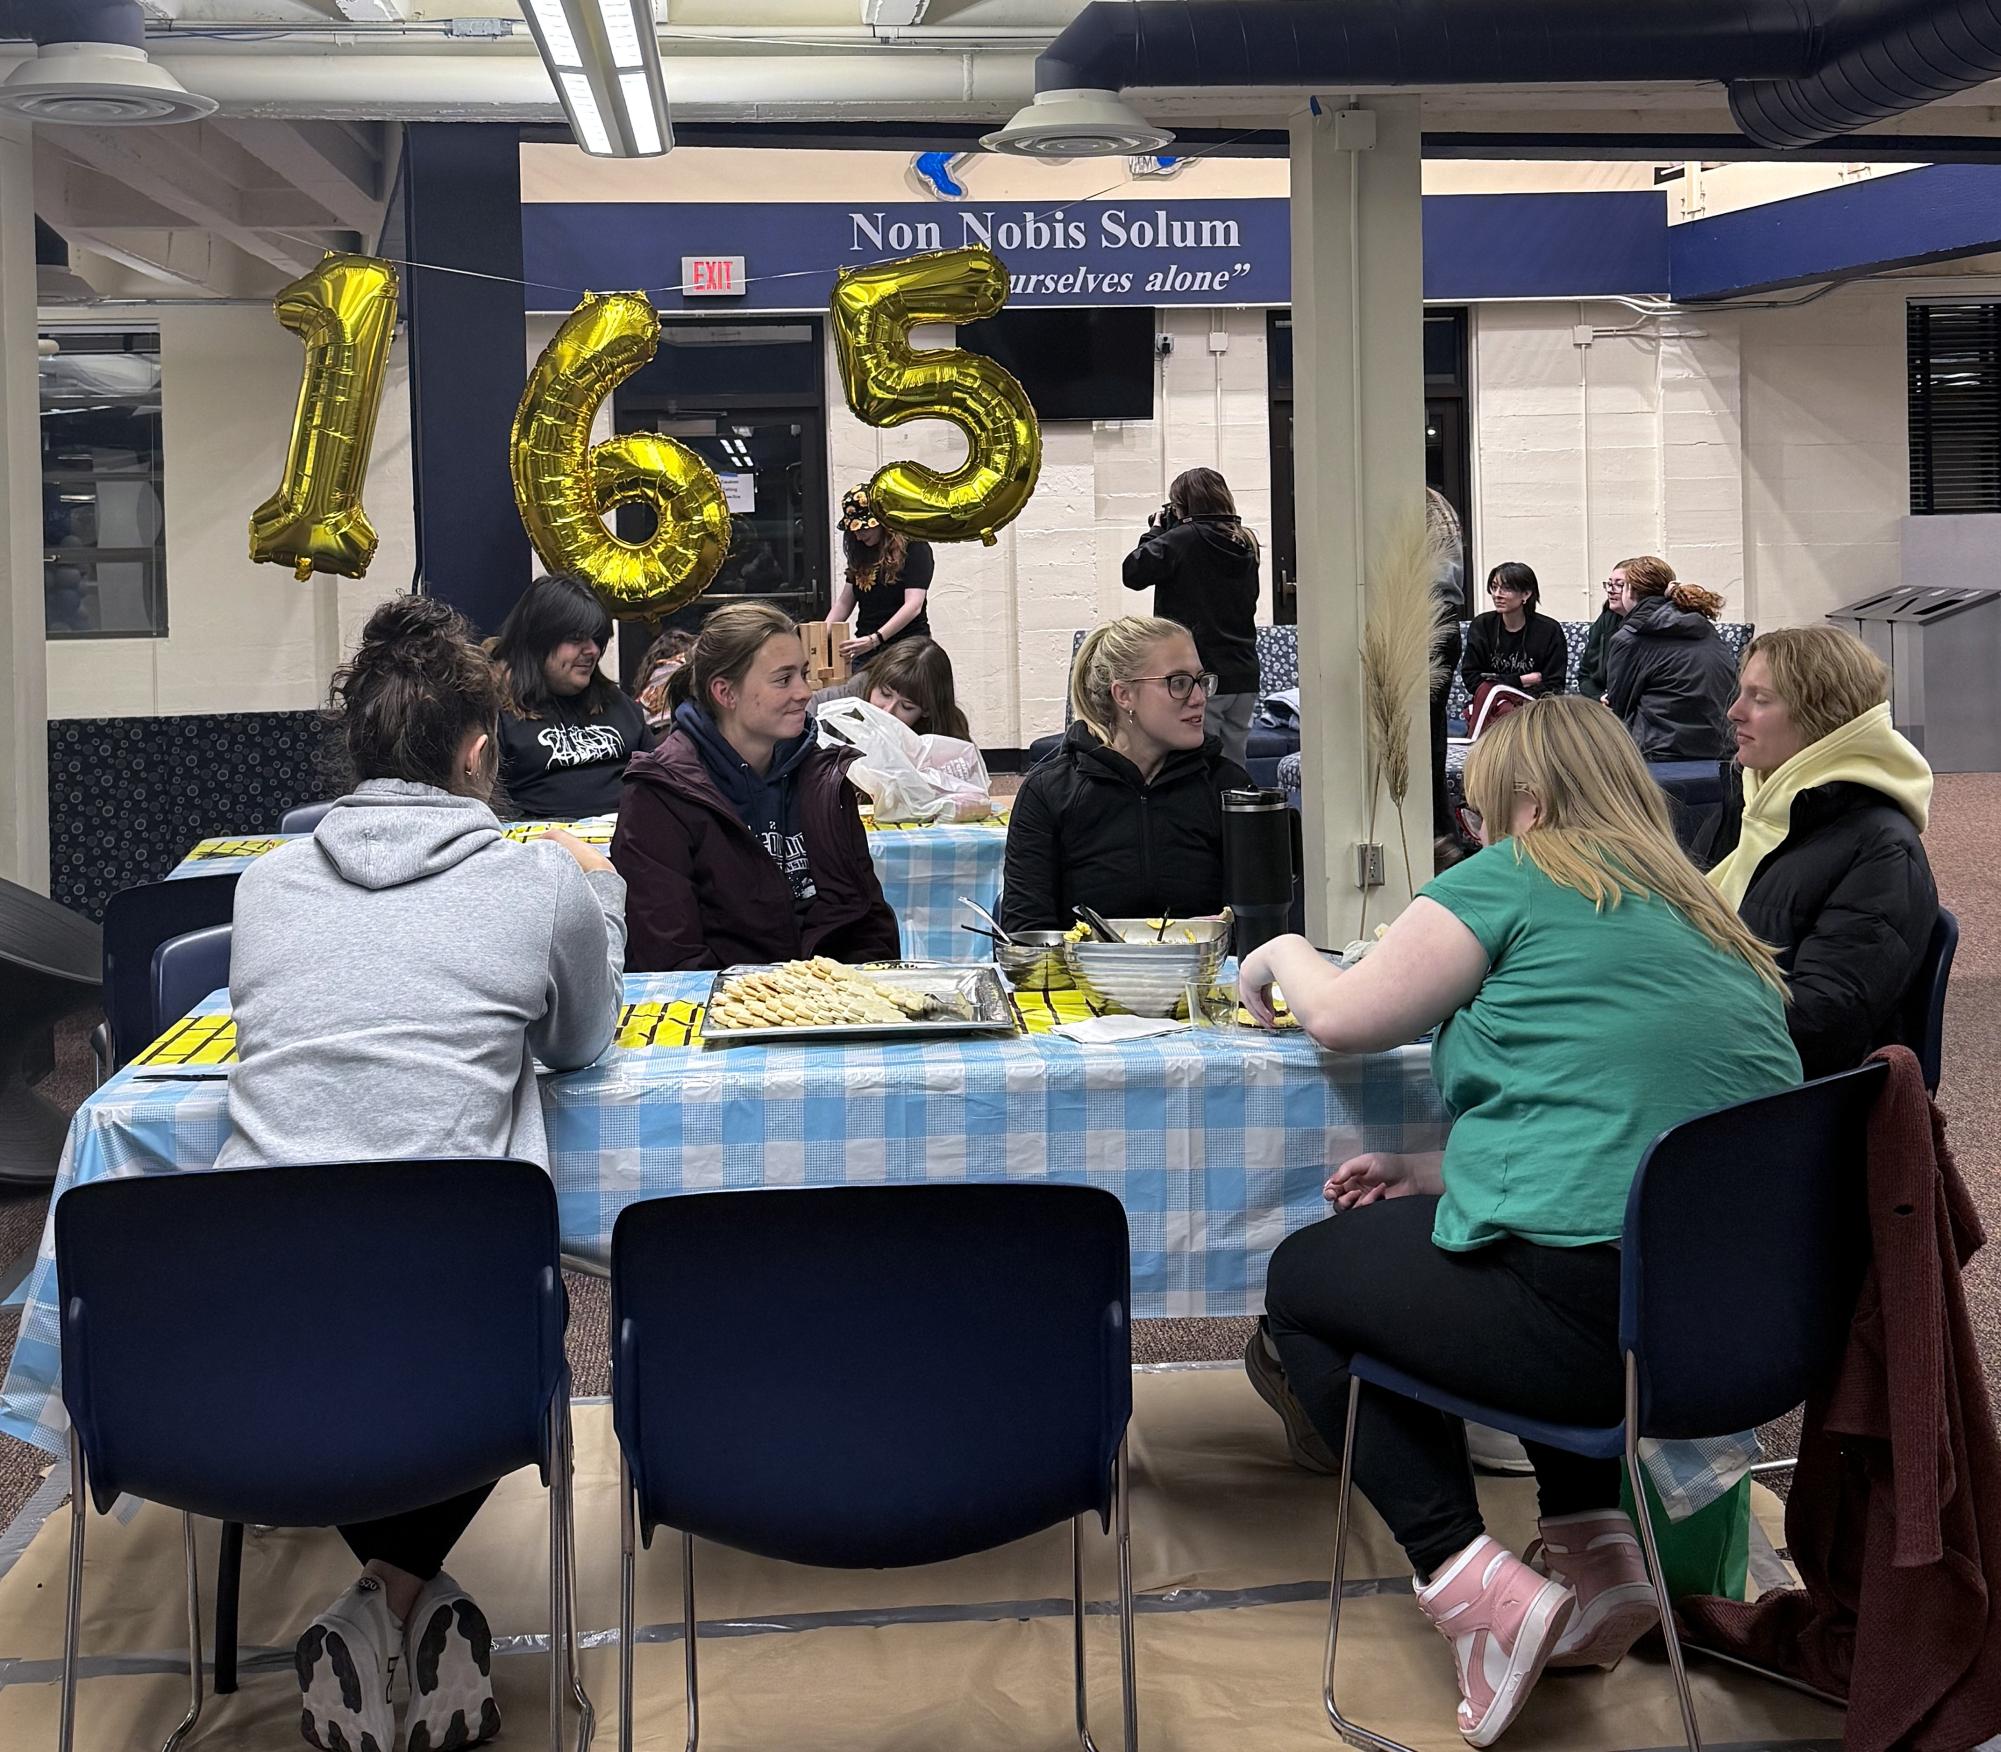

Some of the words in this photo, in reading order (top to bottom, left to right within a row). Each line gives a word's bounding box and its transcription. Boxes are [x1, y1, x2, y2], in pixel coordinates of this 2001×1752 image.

[848, 212, 943, 251] Non
[958, 211, 1087, 251] Nobis
[1101, 210, 1241, 248] Solum
[693, 261, 732, 290] EXIT
[1009, 266, 1133, 294] urselves
[1145, 263, 1251, 292] alone”
